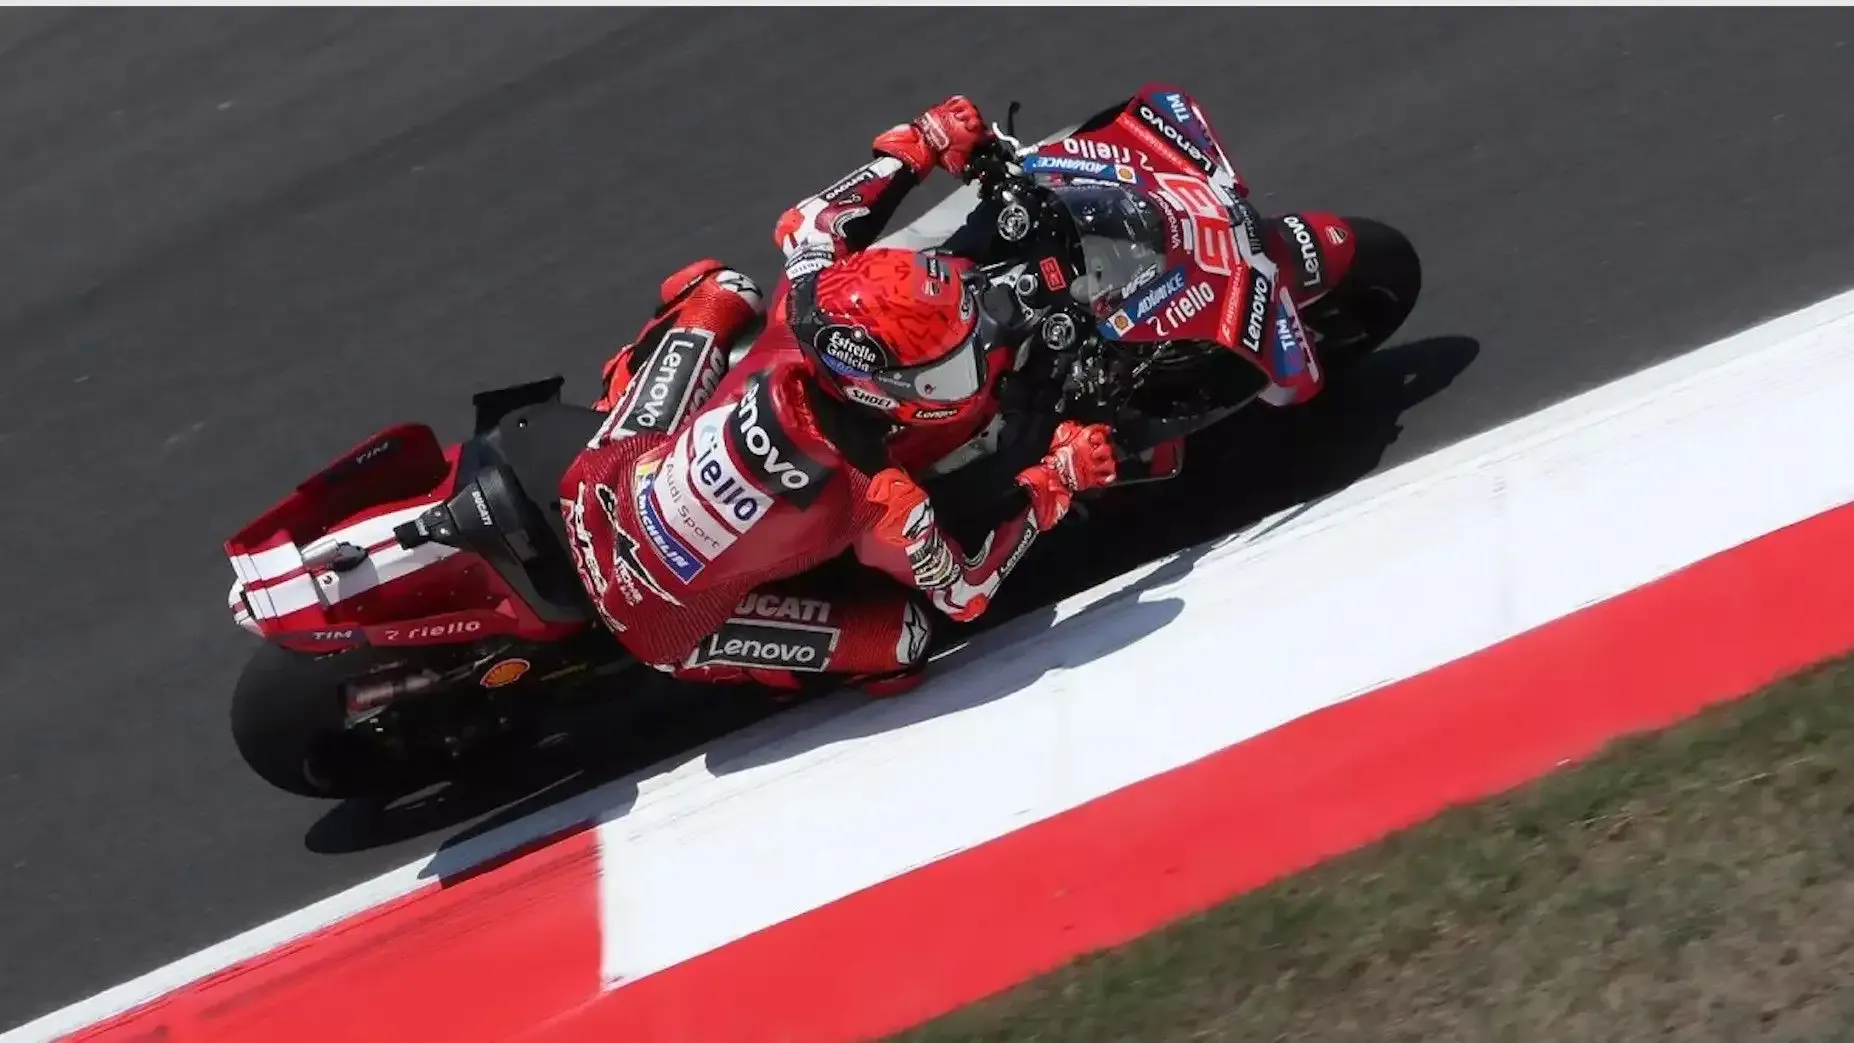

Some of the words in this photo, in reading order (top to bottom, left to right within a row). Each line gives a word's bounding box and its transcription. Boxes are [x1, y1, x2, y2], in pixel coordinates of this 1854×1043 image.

[1166, 93, 1191, 123] TIM
[1063, 138, 1131, 164] riello
[1139, 105, 1213, 172] Lenovo
[1036, 156, 1108, 174] ADVANCE
[1284, 216, 1320, 286] Lenovo
[1165, 282, 1215, 328] riello
[1243, 276, 1268, 352] Lenovo
[830, 331, 877, 363] Estrella
[1275, 319, 1296, 351] TIM
[826, 343, 871, 373] Galicia
[636, 340, 694, 427] Lenovo
[851, 388, 892, 408] SHOEI
[738, 383, 809, 489] enovo
[697, 437, 758, 522] iello
[472, 490, 493, 526] DUCATI
[638, 495, 690, 569] MICHELIN
[678, 505, 720, 549] Sport
[734, 594, 831, 624] UCATI
[313, 629, 353, 641] TIM
[408, 620, 481, 640] riello
[708, 633, 816, 663] Lenovo
